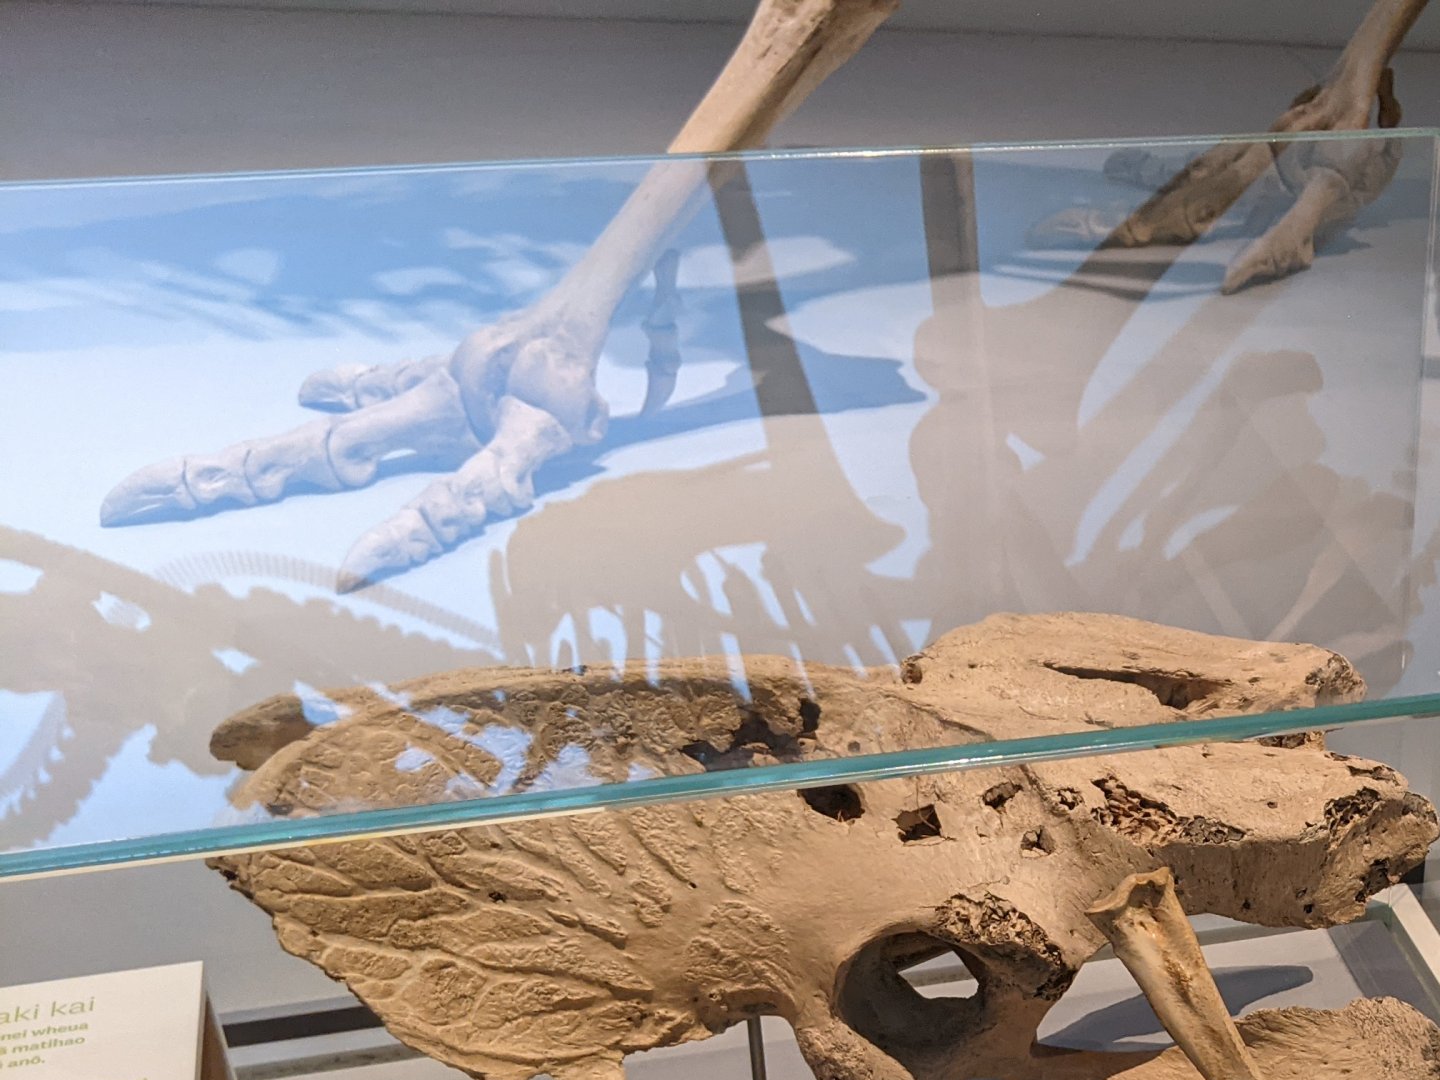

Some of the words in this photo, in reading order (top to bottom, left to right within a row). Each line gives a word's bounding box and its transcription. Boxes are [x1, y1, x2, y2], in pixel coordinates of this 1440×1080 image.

[50, 996, 96, 1019] kai
[31, 1021, 89, 1037] wheua
[12, 1036, 86, 1054] matihao
